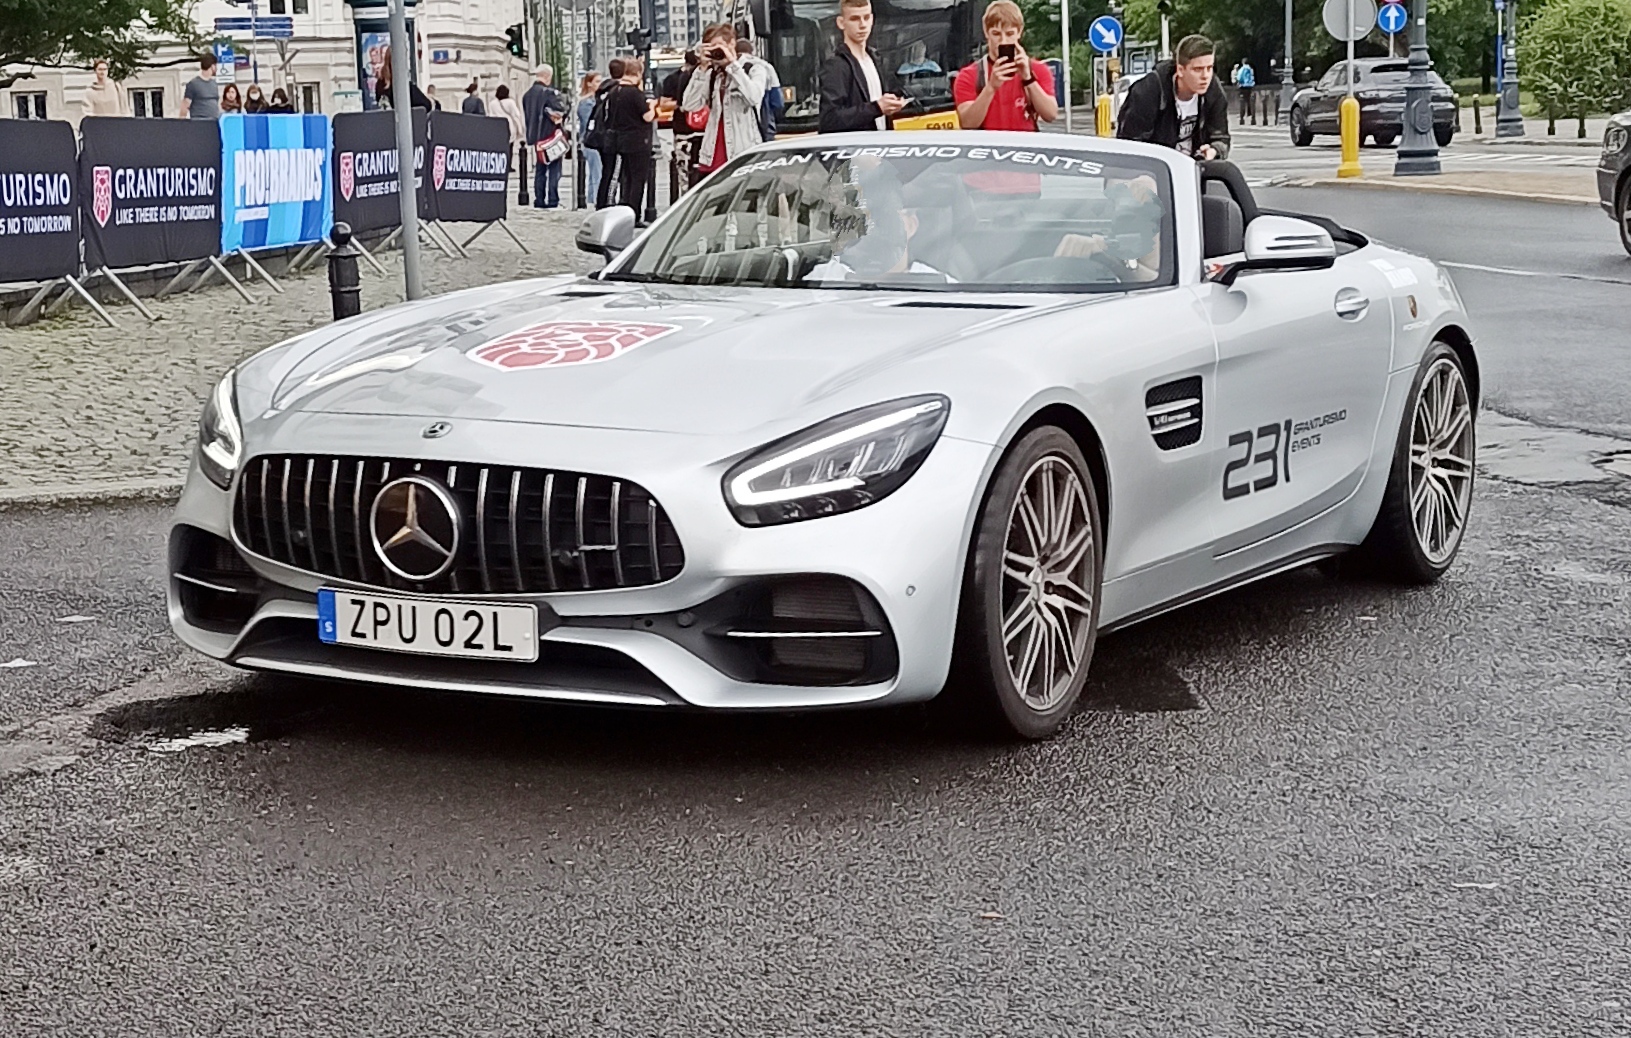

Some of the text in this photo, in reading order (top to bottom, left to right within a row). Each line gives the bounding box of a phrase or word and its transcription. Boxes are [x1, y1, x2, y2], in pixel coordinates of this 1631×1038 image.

[446, 149, 507, 174] GRANTURISMO
[731, 146, 1104, 178] GRAN TURISMO EVENTS
[0, 173, 71, 207] URISMO
[115, 167, 216, 199] GRANTURISMO
[7, 217, 21, 234] NO
[22, 215, 72, 233] TOMORROW
[116, 208, 134, 226] LIKE
[135, 206, 159, 223] THERE
[167, 206, 178, 221] NO
[1291, 433, 1321, 453] EVENTS
[1222, 418, 1293, 502] 231
[325, 621, 333, 633] S
[350, 598, 514, 652] ZPU 02L
